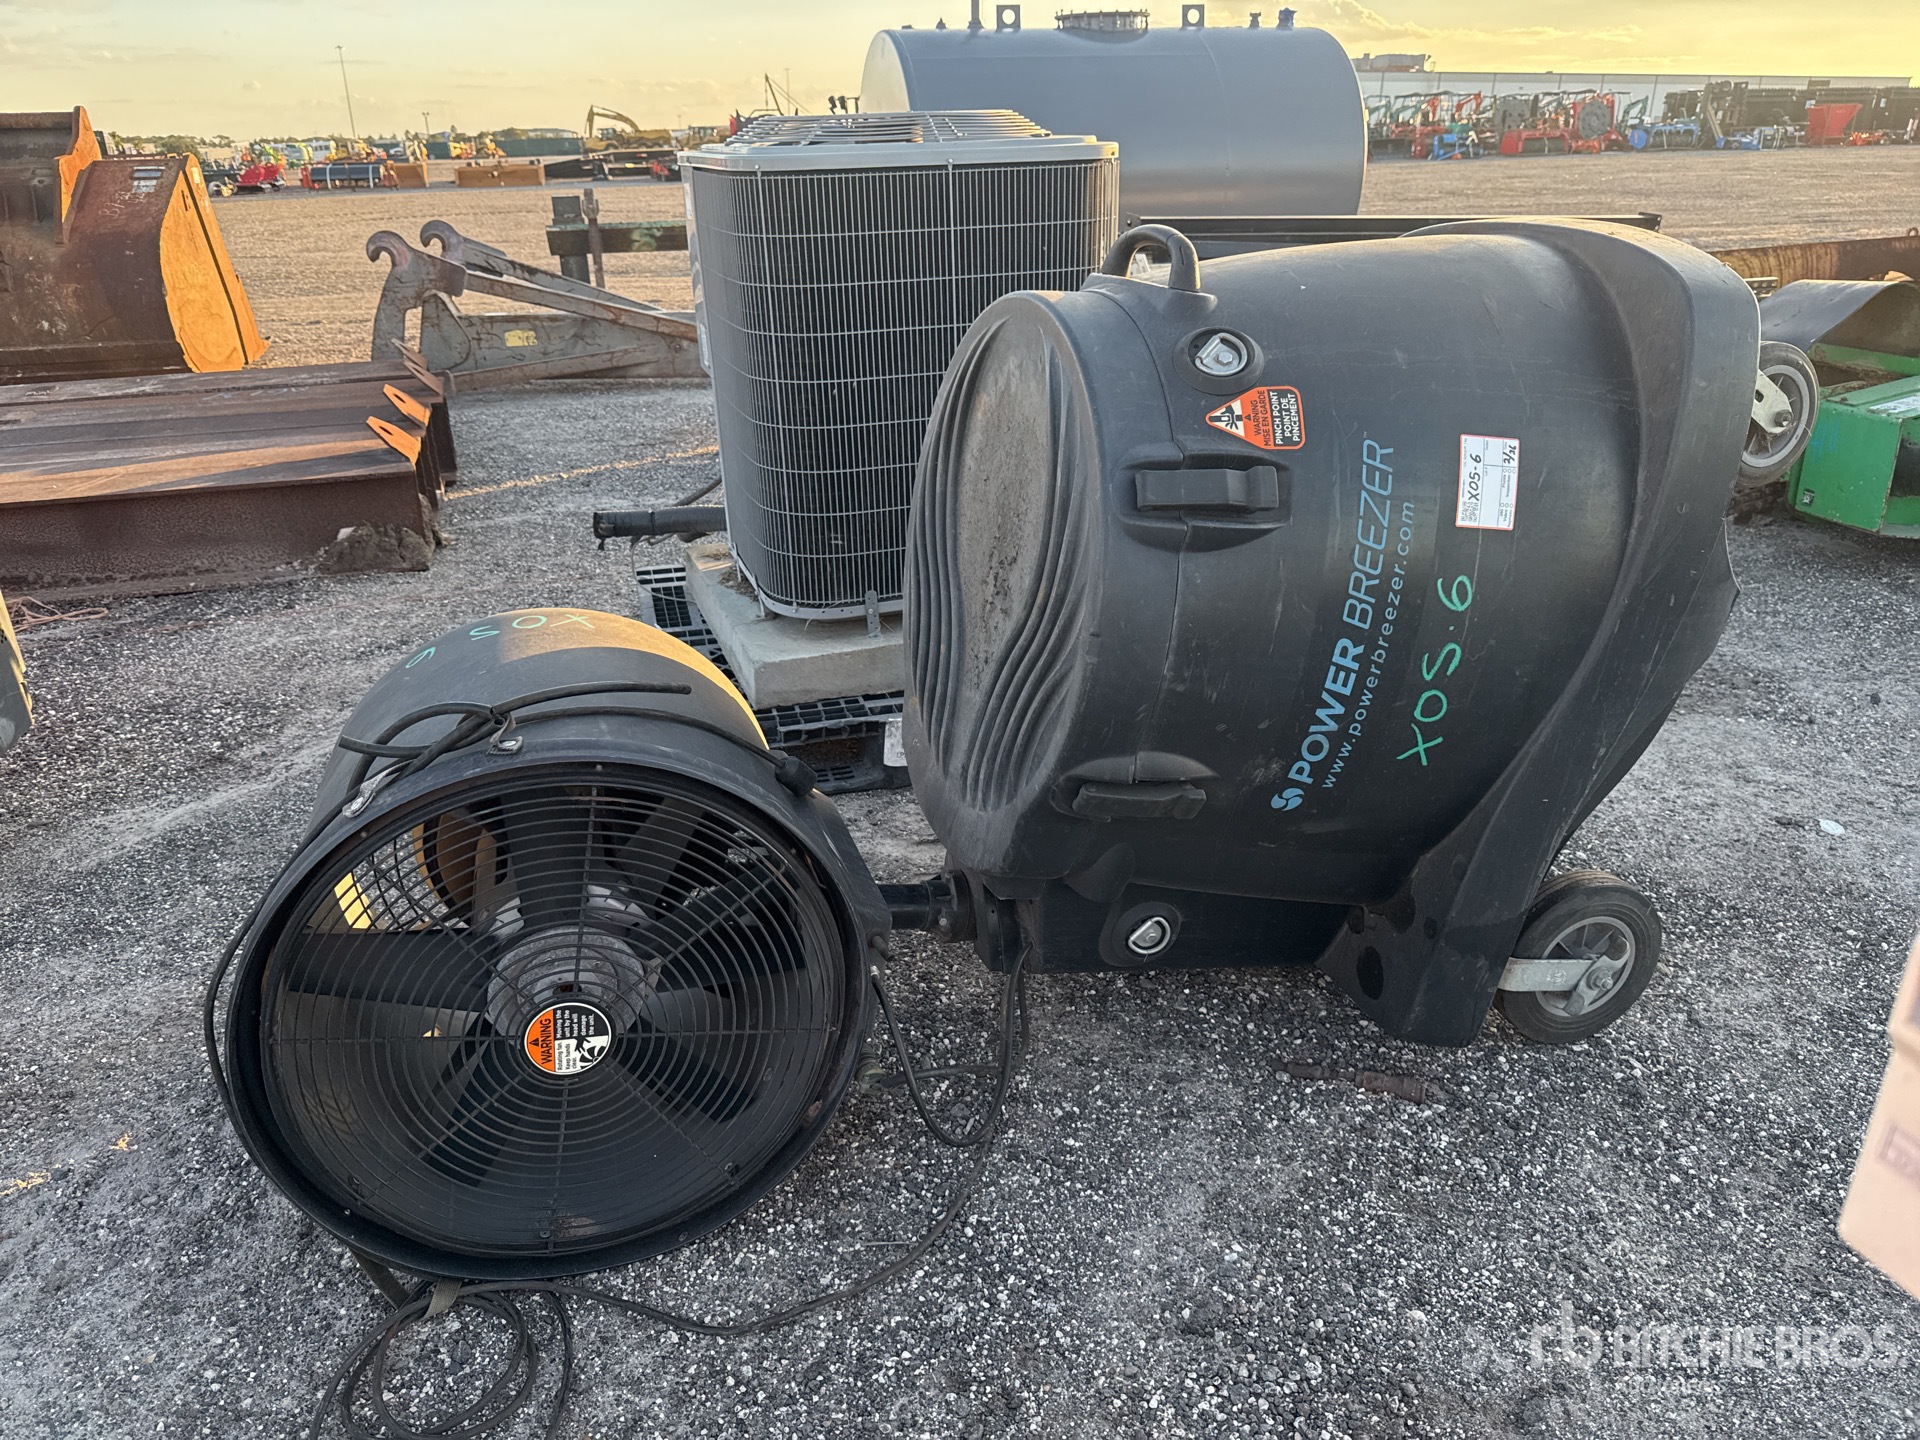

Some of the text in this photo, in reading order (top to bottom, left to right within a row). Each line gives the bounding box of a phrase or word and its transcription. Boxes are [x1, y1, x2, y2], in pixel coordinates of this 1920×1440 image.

[1251, 400, 1260, 436] WARNING
[1258, 390, 1271, 446] MISE EN GARDE
[1270, 391, 1284, 444] PINCH POINT
[1280, 398, 1292, 437] POINT DE
[1288, 393, 1300, 442] PINCEMENT
[1287, 637, 1365, 785] POWER
[1343, 439, 1394, 630] BREEZER
[1322, 502, 1415, 788] www.powerbreezer.com
[540, 1018, 553, 1065] WARNING
[564, 1019, 571, 1027] by
